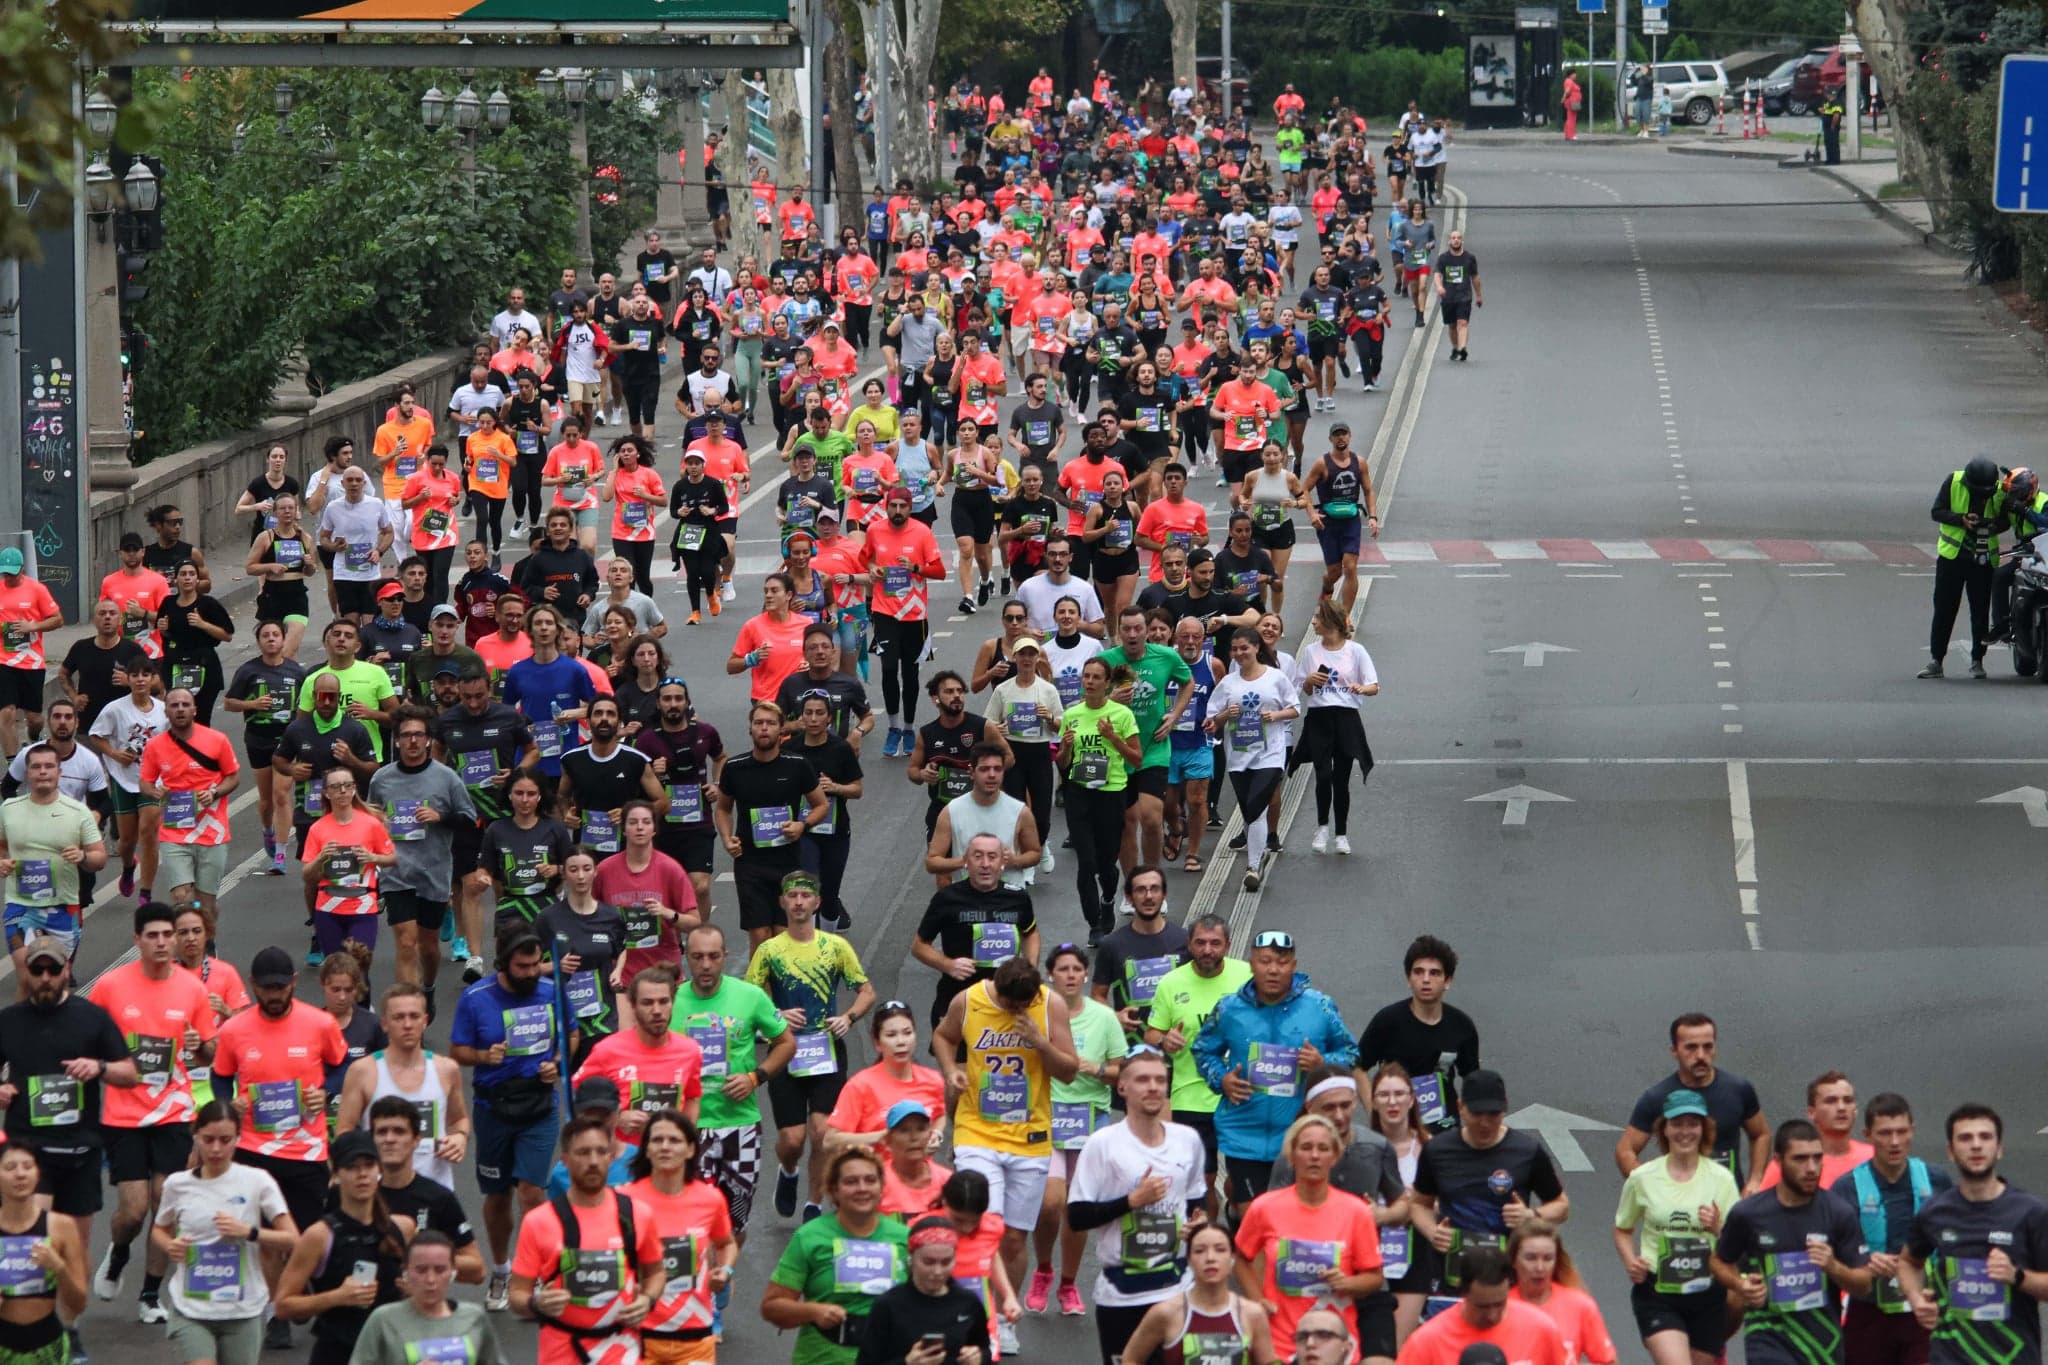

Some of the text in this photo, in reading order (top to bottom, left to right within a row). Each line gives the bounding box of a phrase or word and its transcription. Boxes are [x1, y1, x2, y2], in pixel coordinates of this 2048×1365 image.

[575, 333, 591, 343] JSL
[1080, 735, 1102, 747] WE
[1086, 766, 1096, 774] 13
